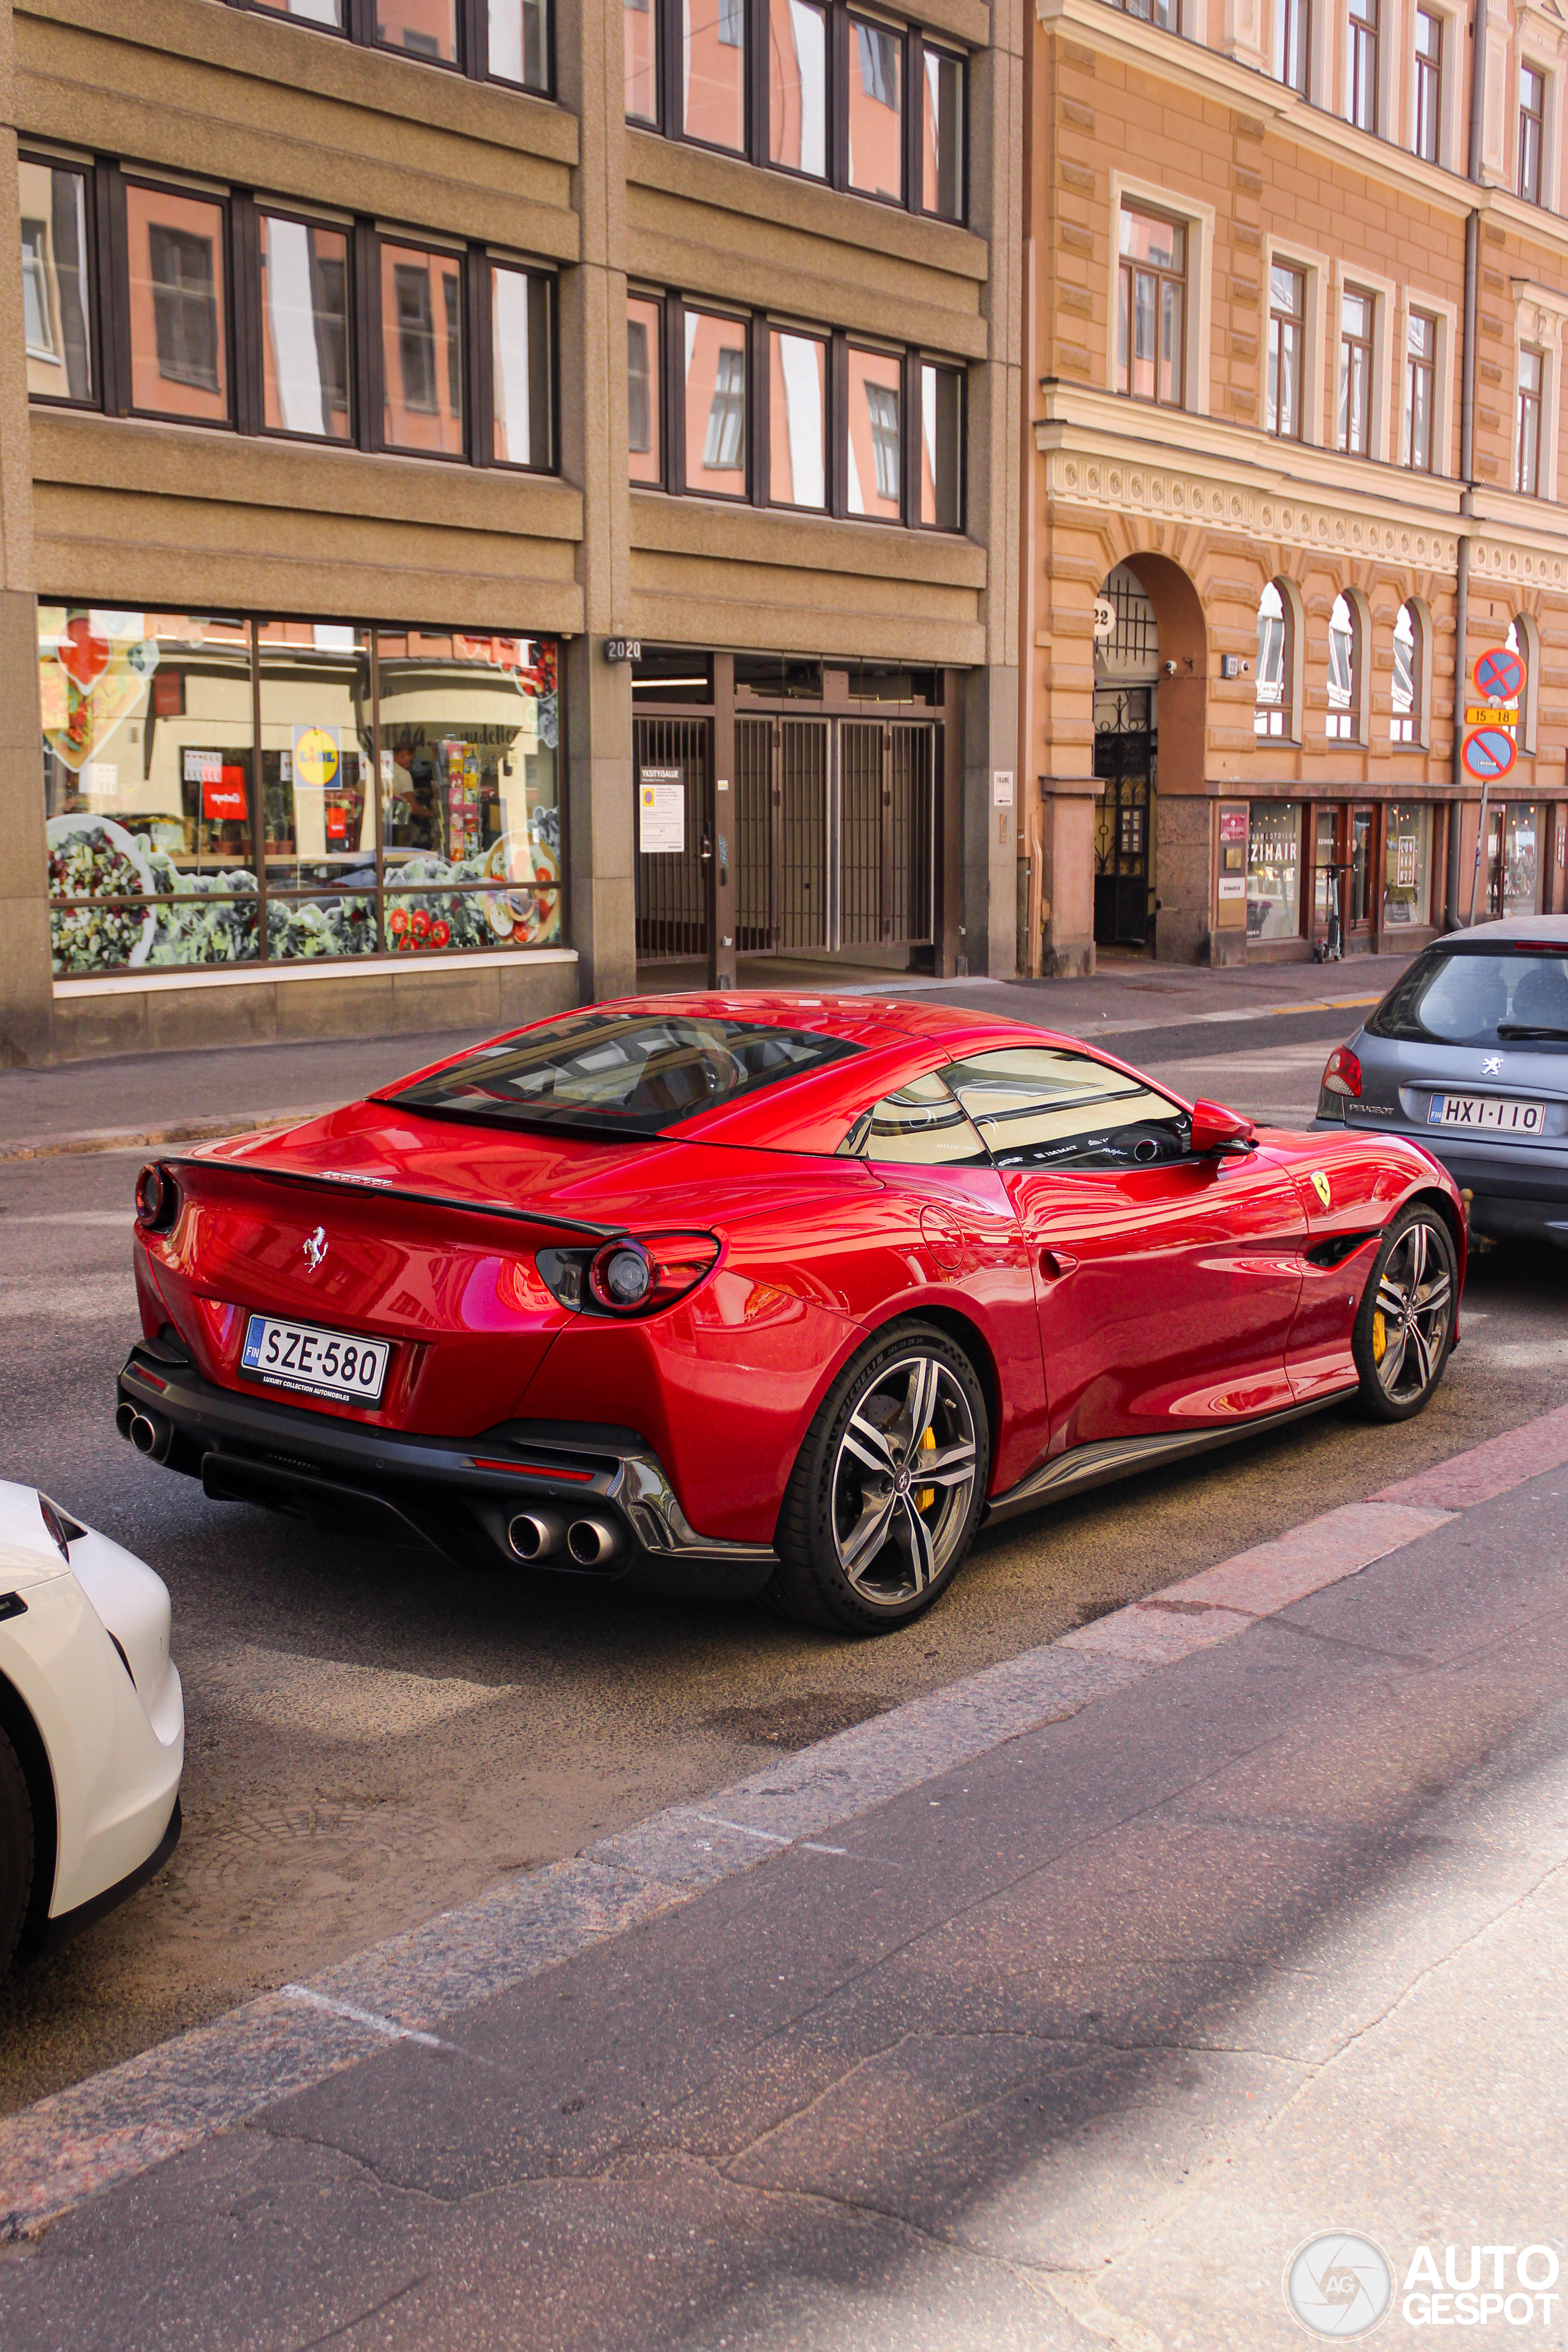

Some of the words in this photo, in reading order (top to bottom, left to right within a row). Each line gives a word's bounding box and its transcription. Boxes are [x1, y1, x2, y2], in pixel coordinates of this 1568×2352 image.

[609, 641, 625, 657] 20
[626, 641, 641, 658] 20
[1230, 660, 1237, 671] 22
[1477, 710, 1486, 722] 15
[1498, 711, 1509, 722] 18
[641, 769, 679, 778] YKSITYISALUE
[1349, 1103, 1395, 1115] PEUGEOT
[1446, 1100, 1537, 1128] HXI-110
[246, 1346, 260, 1359] FIN
[265, 1329, 377, 1385] SZE-580
[263, 1376, 283, 1386] LUXURY
[283, 1381, 313, 1393] COLLECTION
[313, 1387, 350, 1401] AUTOMOBILES
[840, 1353, 883, 1420] MICHELIN
